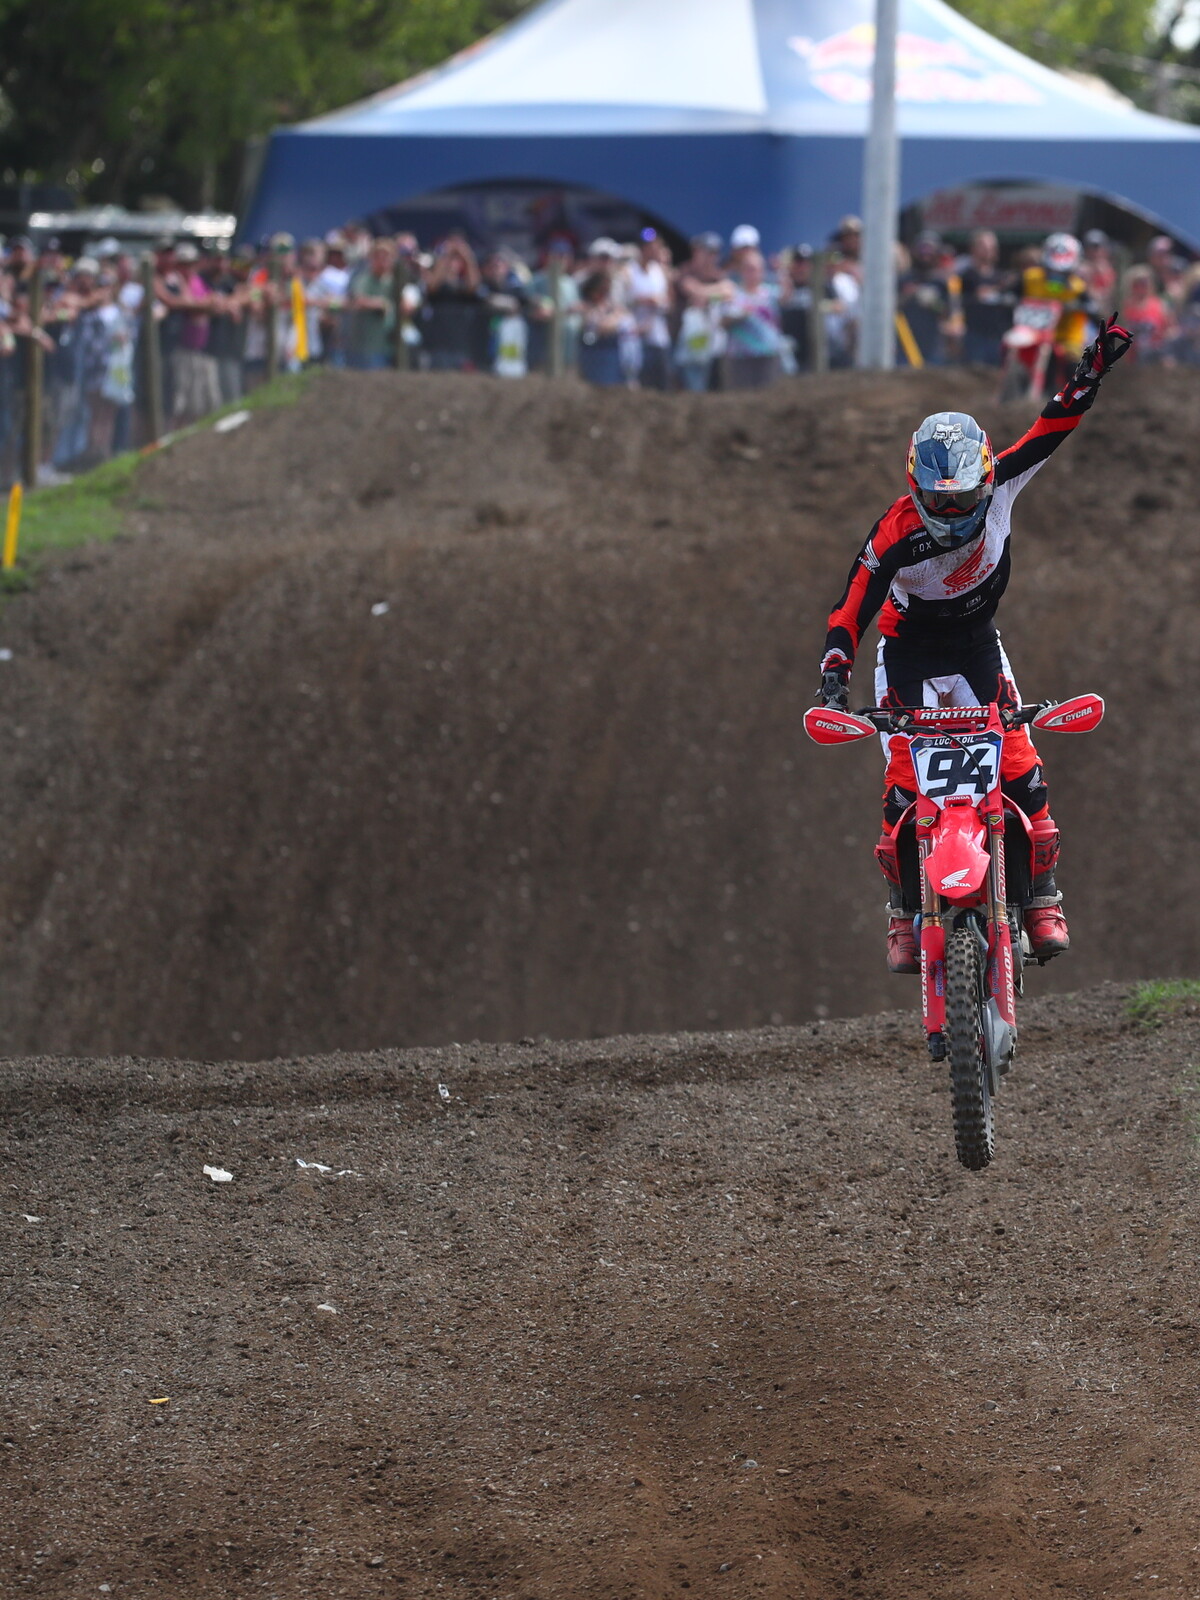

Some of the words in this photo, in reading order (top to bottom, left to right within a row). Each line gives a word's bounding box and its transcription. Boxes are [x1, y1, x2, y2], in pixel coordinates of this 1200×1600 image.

[912, 541, 932, 556] FOX
[944, 563, 995, 596] HONDA
[920, 709, 991, 720] RENTHAL
[1065, 706, 1093, 722] CYCRA
[815, 719, 844, 733] CYCRA
[934, 737, 961, 747] LUC
[962, 736, 975, 744] OIL
[925, 748, 994, 798] 94
[941, 883, 973, 891] HONDA
[1003, 946, 1014, 1017] DUNLOP
